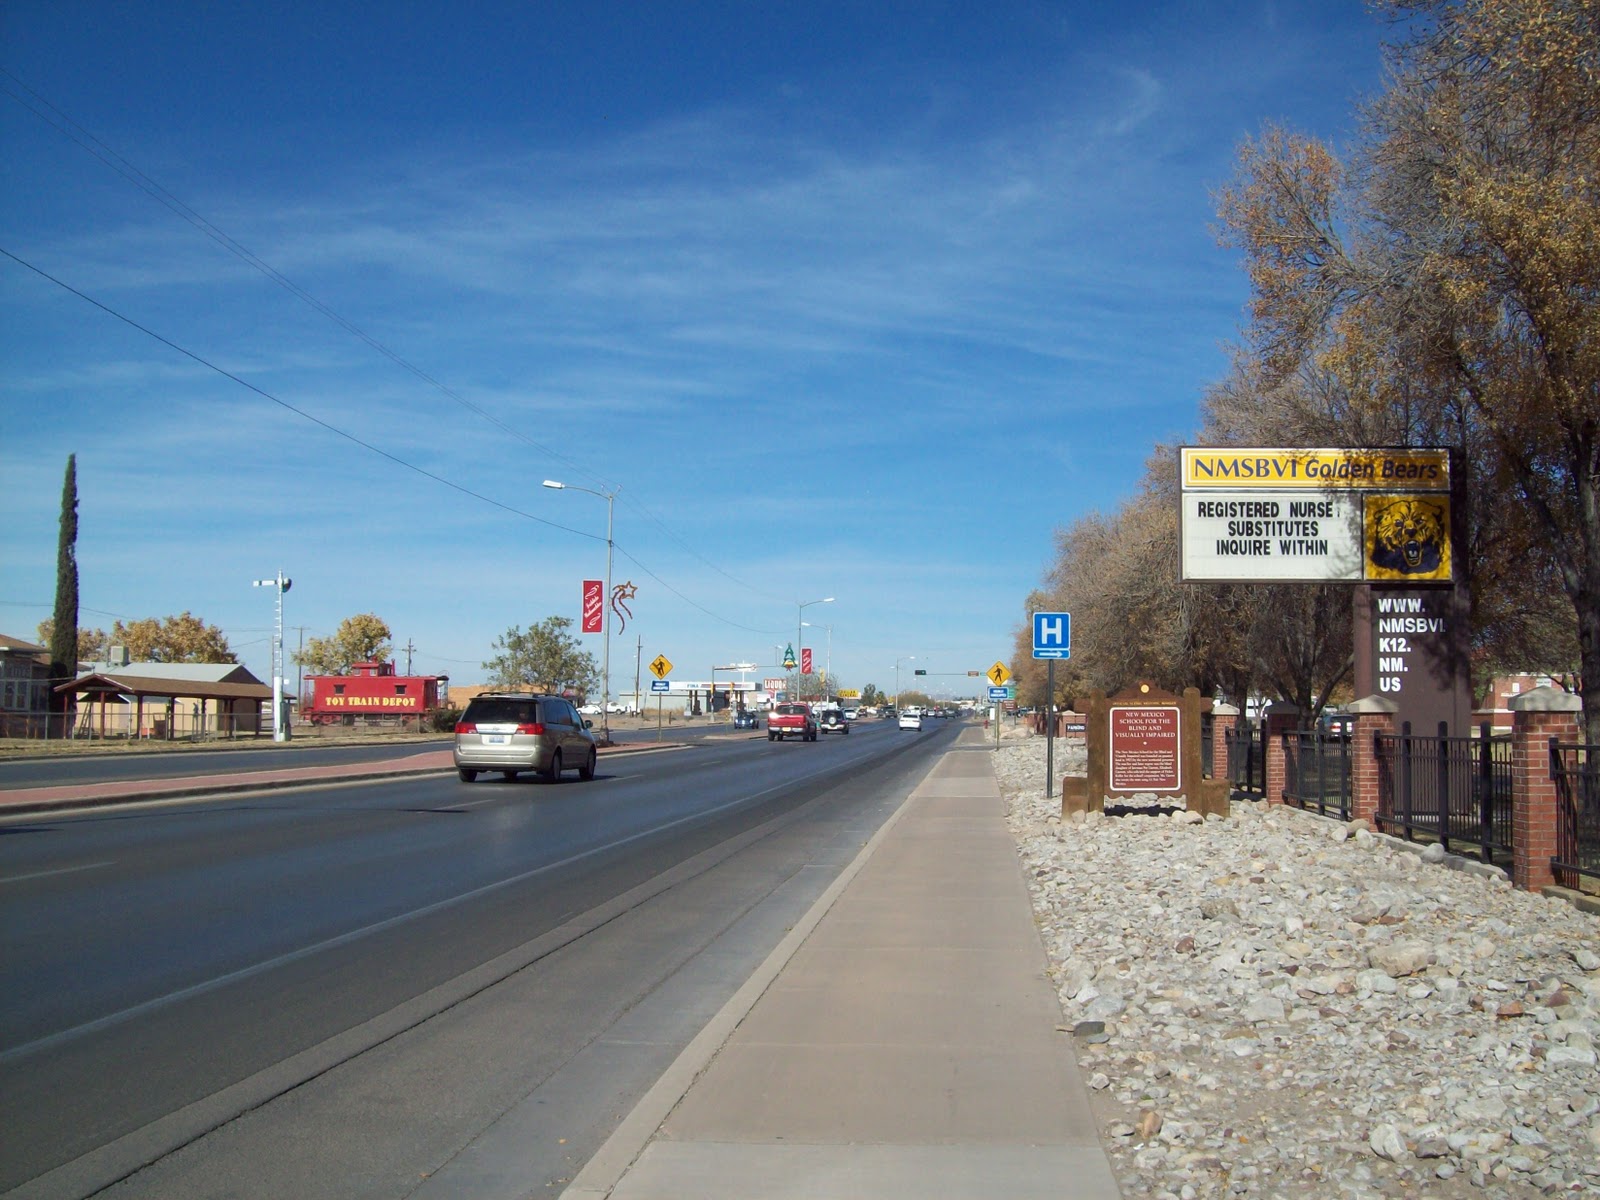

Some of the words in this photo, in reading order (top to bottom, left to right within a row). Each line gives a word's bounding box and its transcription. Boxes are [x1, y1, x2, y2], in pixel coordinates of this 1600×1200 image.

[1194, 458, 1297, 478] NMSBVI
[1305, 458, 1374, 479] Golden
[1382, 459, 1438, 479] Bears
[1198, 502, 1279, 518] REGISTERED
[1228, 521, 1319, 537] SUBSTITUTES
[1216, 540, 1271, 555] INQUIRE
[1280, 539, 1328, 555] WITHIN
[1378, 598, 1425, 613] WWW.
[1041, 617, 1062, 645] H
[1379, 638, 1411, 652] K12.
[1379, 657, 1408, 672] NM.
[1379, 677, 1401, 692] US
[325, 697, 345, 706] TOY
[348, 696, 380, 706] TRAIN
[382, 697, 416, 707] DEPOT
